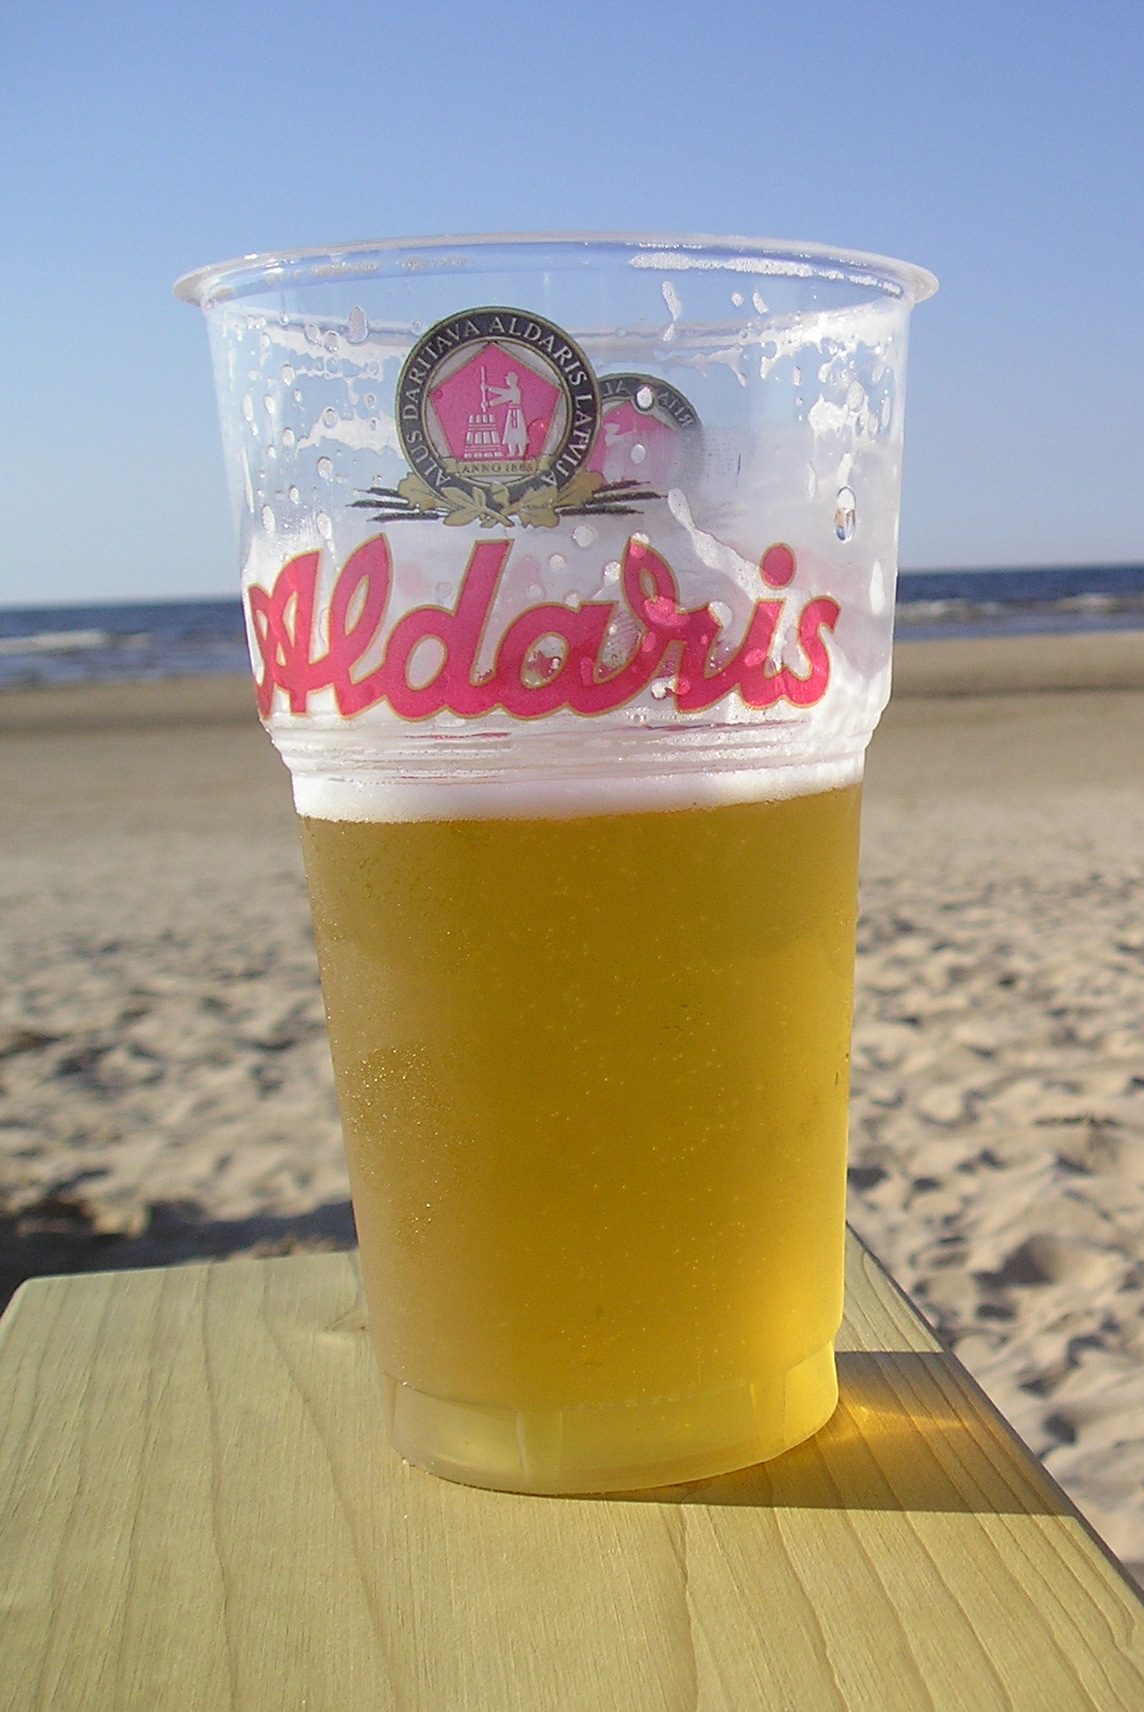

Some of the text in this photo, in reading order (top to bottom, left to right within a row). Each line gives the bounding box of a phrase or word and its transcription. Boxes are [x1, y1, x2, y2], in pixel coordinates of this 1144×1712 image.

[404, 431, 454, 487] ALUS
[489, 315, 589, 387] ALDARIS
[541, 393, 593, 488] LATVIJA
[462, 463, 501, 474] ANNO
[247, 532, 842, 723] Aldaris
